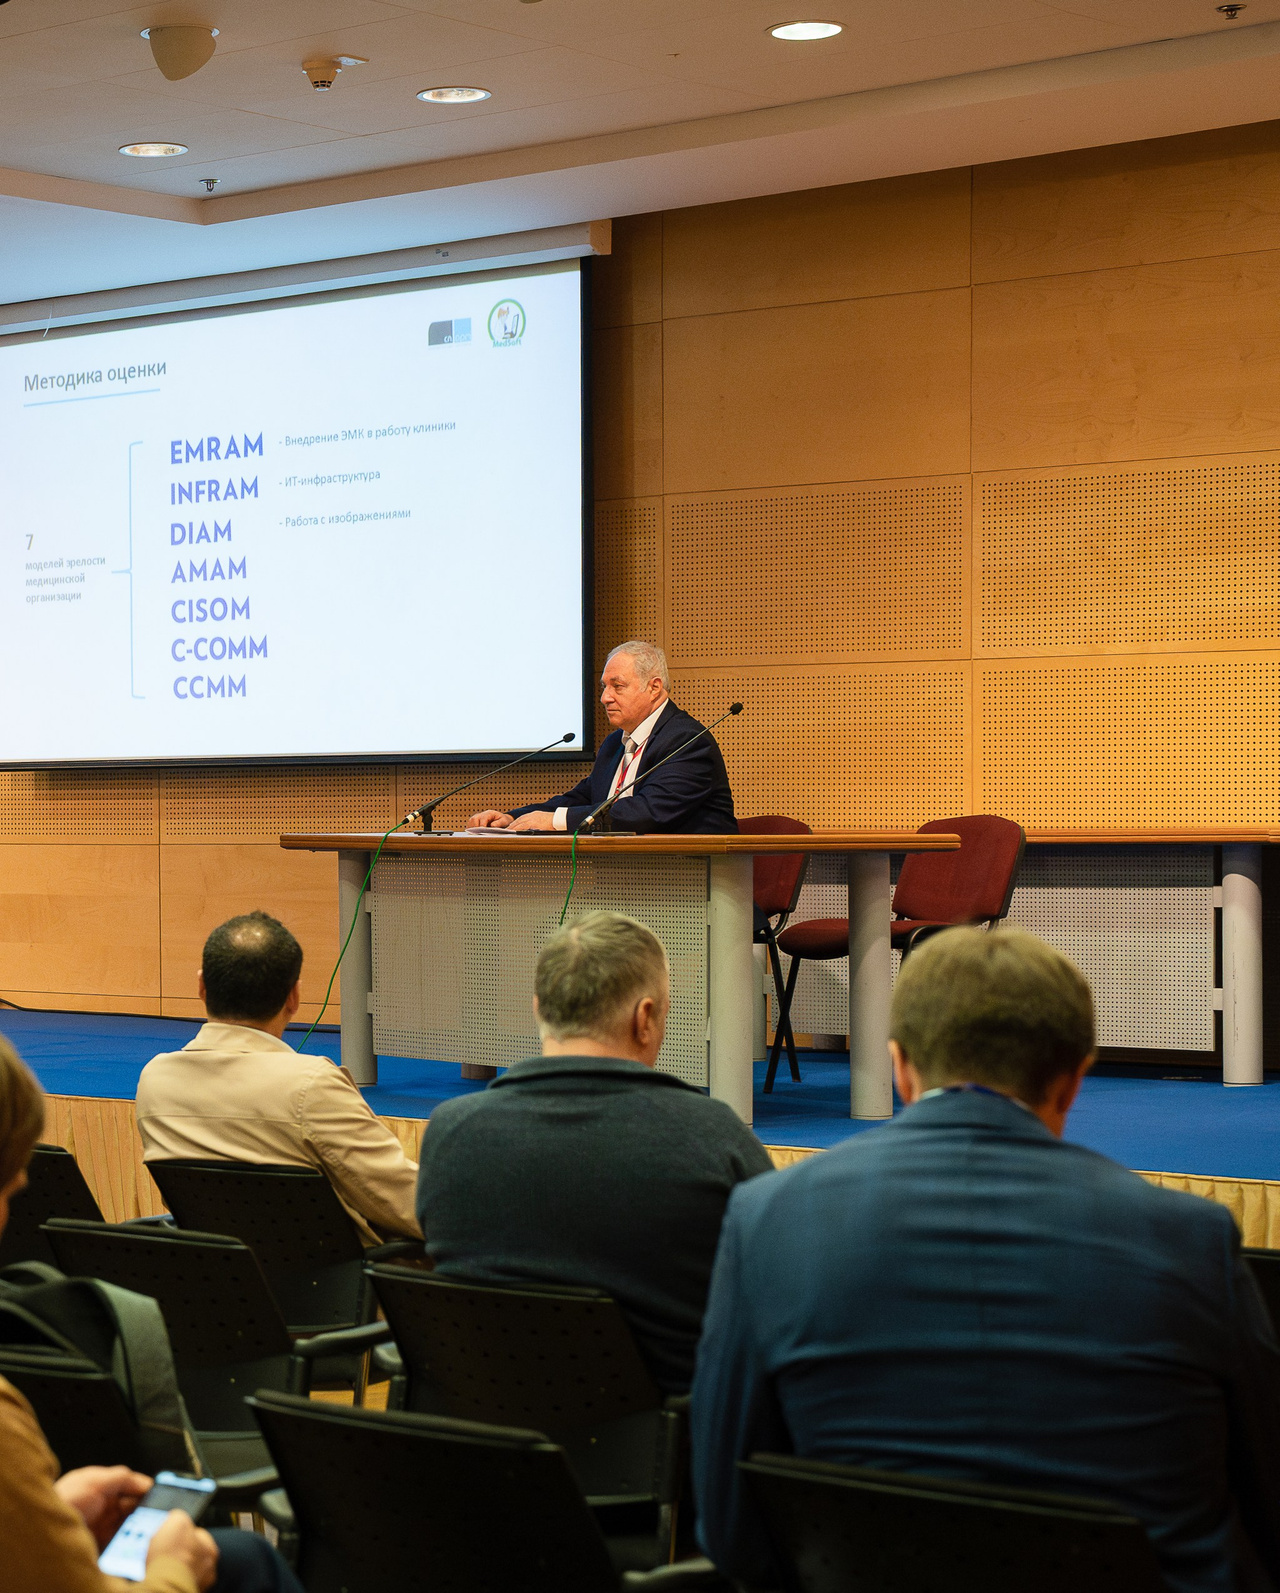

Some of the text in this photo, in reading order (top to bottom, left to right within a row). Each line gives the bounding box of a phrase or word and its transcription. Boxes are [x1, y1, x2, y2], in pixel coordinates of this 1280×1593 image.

[493, 338, 522, 348] MedSoft
[24, 362, 166, 391] Методика оценки
[285, 434, 339, 447] Внедрение
[341, 429, 365, 441] ЭМК
[367, 430, 373, 439] в
[375, 425, 411, 440] работу
[413, 422, 456, 433] клиники
[171, 431, 263, 464] EMRAM
[171, 475, 258, 505] INFRAM
[285, 470, 381, 487] ИТ-инфраструктура
[285, 516, 319, 527] Работа
[328, 510, 411, 524] изображениями
[25, 533, 34, 550] 7
[171, 519, 232, 546] DIAM
[25, 557, 106, 571] моделей зрелости
[171, 556, 247, 583] AMAM
[25, 573, 86, 587] медицинской
[25, 592, 82, 605] организации
[171, 595, 250, 623] CISOM
[171, 634, 268, 662] C-COMM
[173, 674, 246, 699] CCMM
